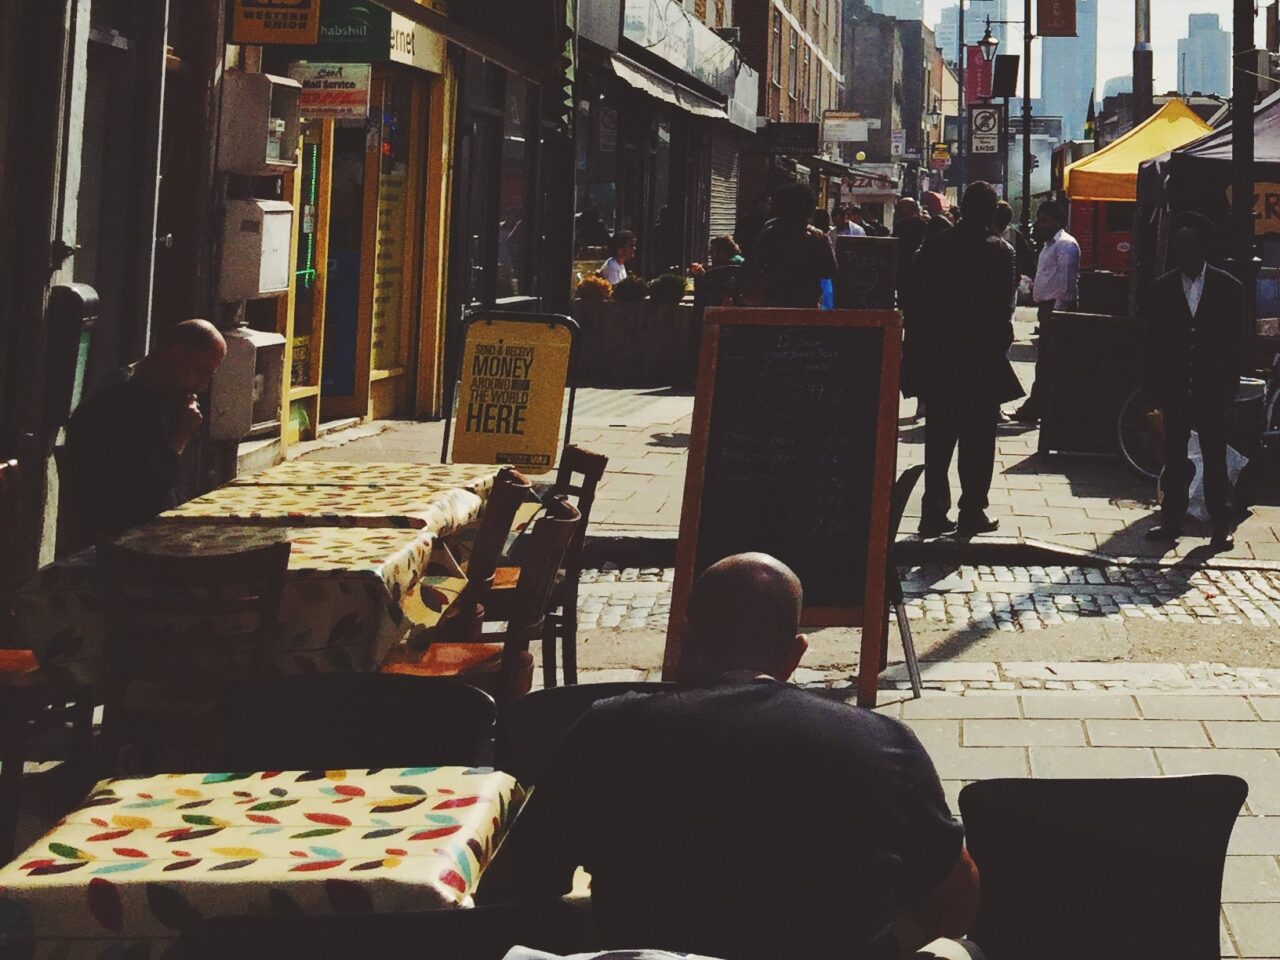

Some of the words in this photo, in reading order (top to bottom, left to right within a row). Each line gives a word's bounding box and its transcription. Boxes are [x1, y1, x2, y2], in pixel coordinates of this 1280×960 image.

[243, 11, 309, 21] WESTERN
[263, 21, 308, 30] UNION
[323, 80, 356, 89] Service
[505, 345, 535, 358] RECEIVE
[472, 356, 534, 378] MONEY
[471, 377, 510, 390] AROUND
[470, 389, 488, 403] THE
[491, 390, 529, 405] WORLD
[466, 404, 527, 435] HERE
